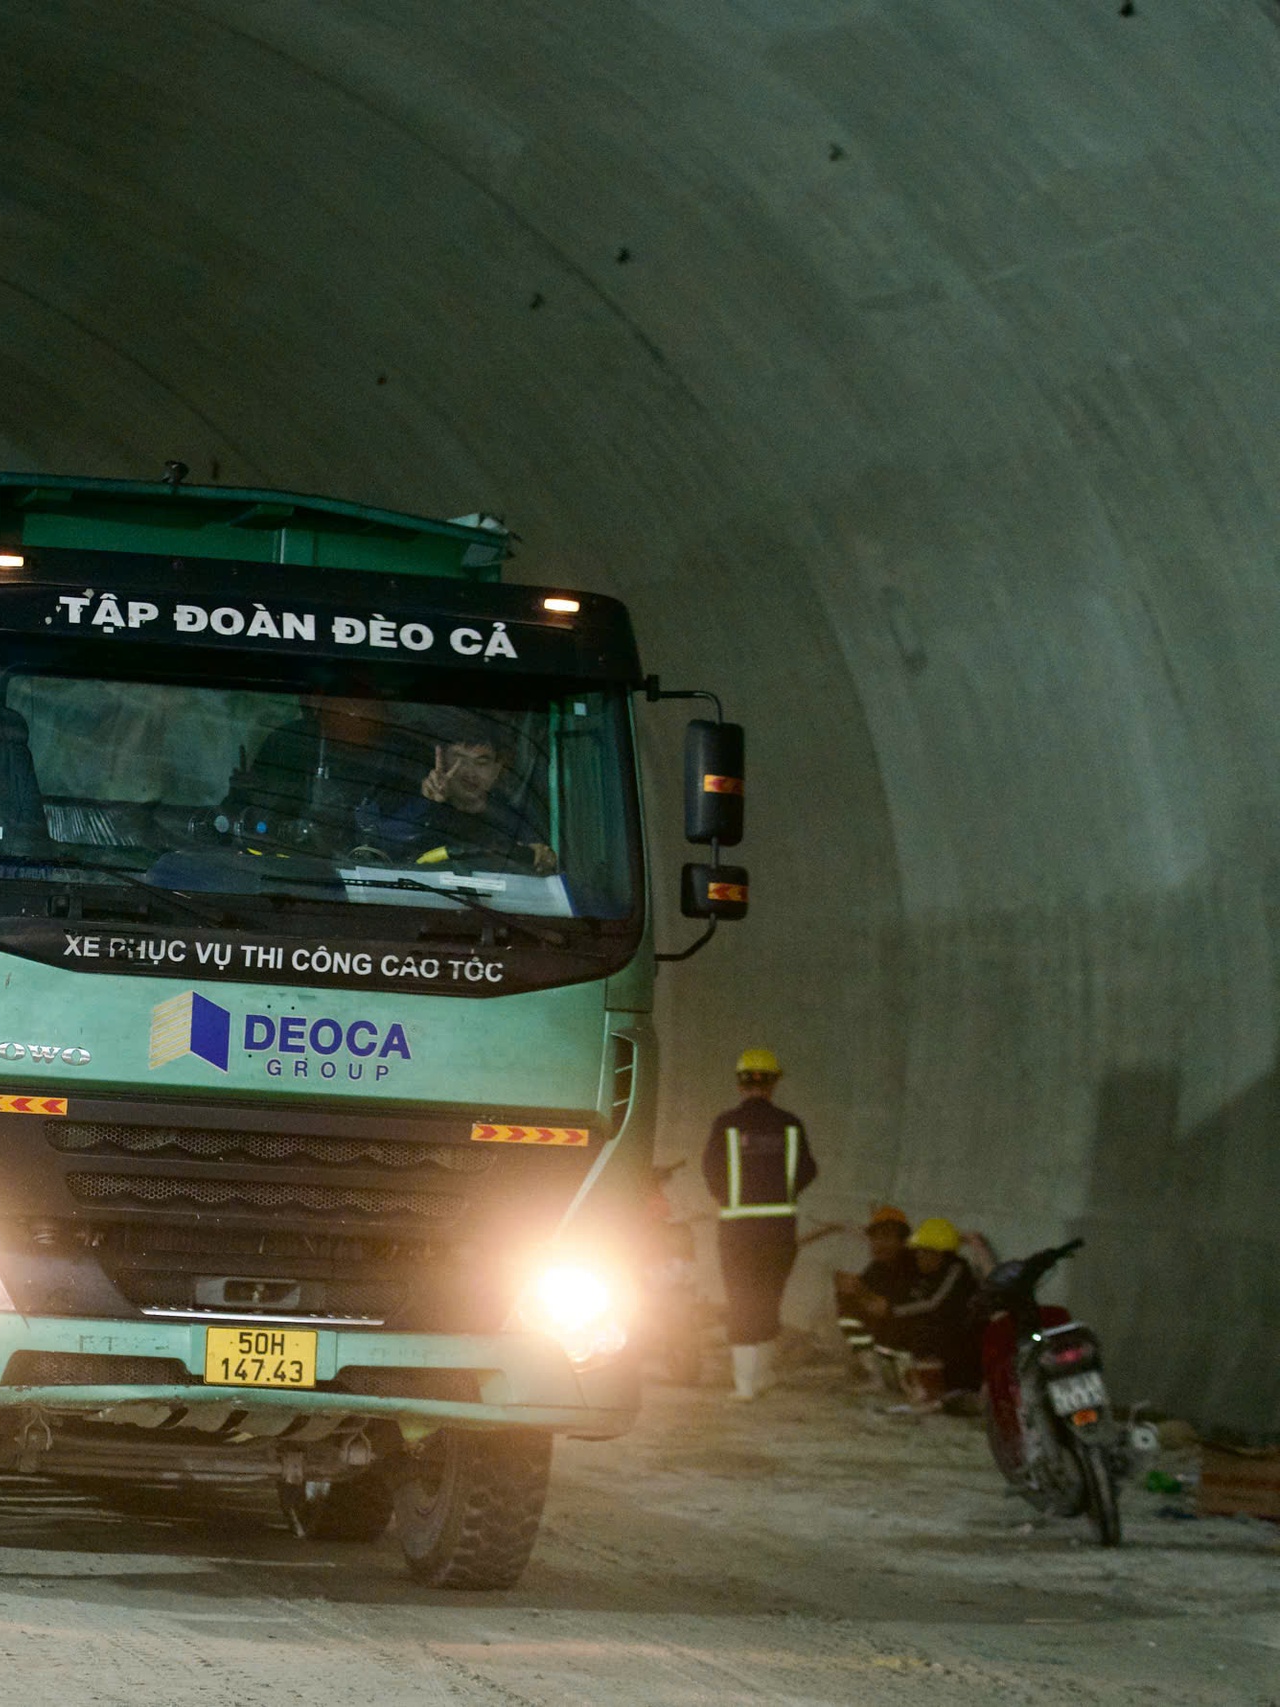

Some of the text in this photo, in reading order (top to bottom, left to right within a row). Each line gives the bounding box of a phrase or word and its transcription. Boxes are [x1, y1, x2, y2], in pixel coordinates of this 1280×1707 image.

[59, 593, 518, 659] TẬP ĐOÀN ĐÈO CẢ
[63, 934, 101, 958] XE
[109, 937, 187, 965] PHỤC
[195, 942, 232, 971] VỤ
[240, 945, 283, 969] THI
[291, 945, 373, 976] CÔNG
[380, 954, 440, 979] CAO
[243, 1014, 412, 1060] DEOCA
[266, 1058, 390, 1082] GROUP
[238, 1331, 285, 1356] 50H
[221, 1357, 304, 1383] 147.43
